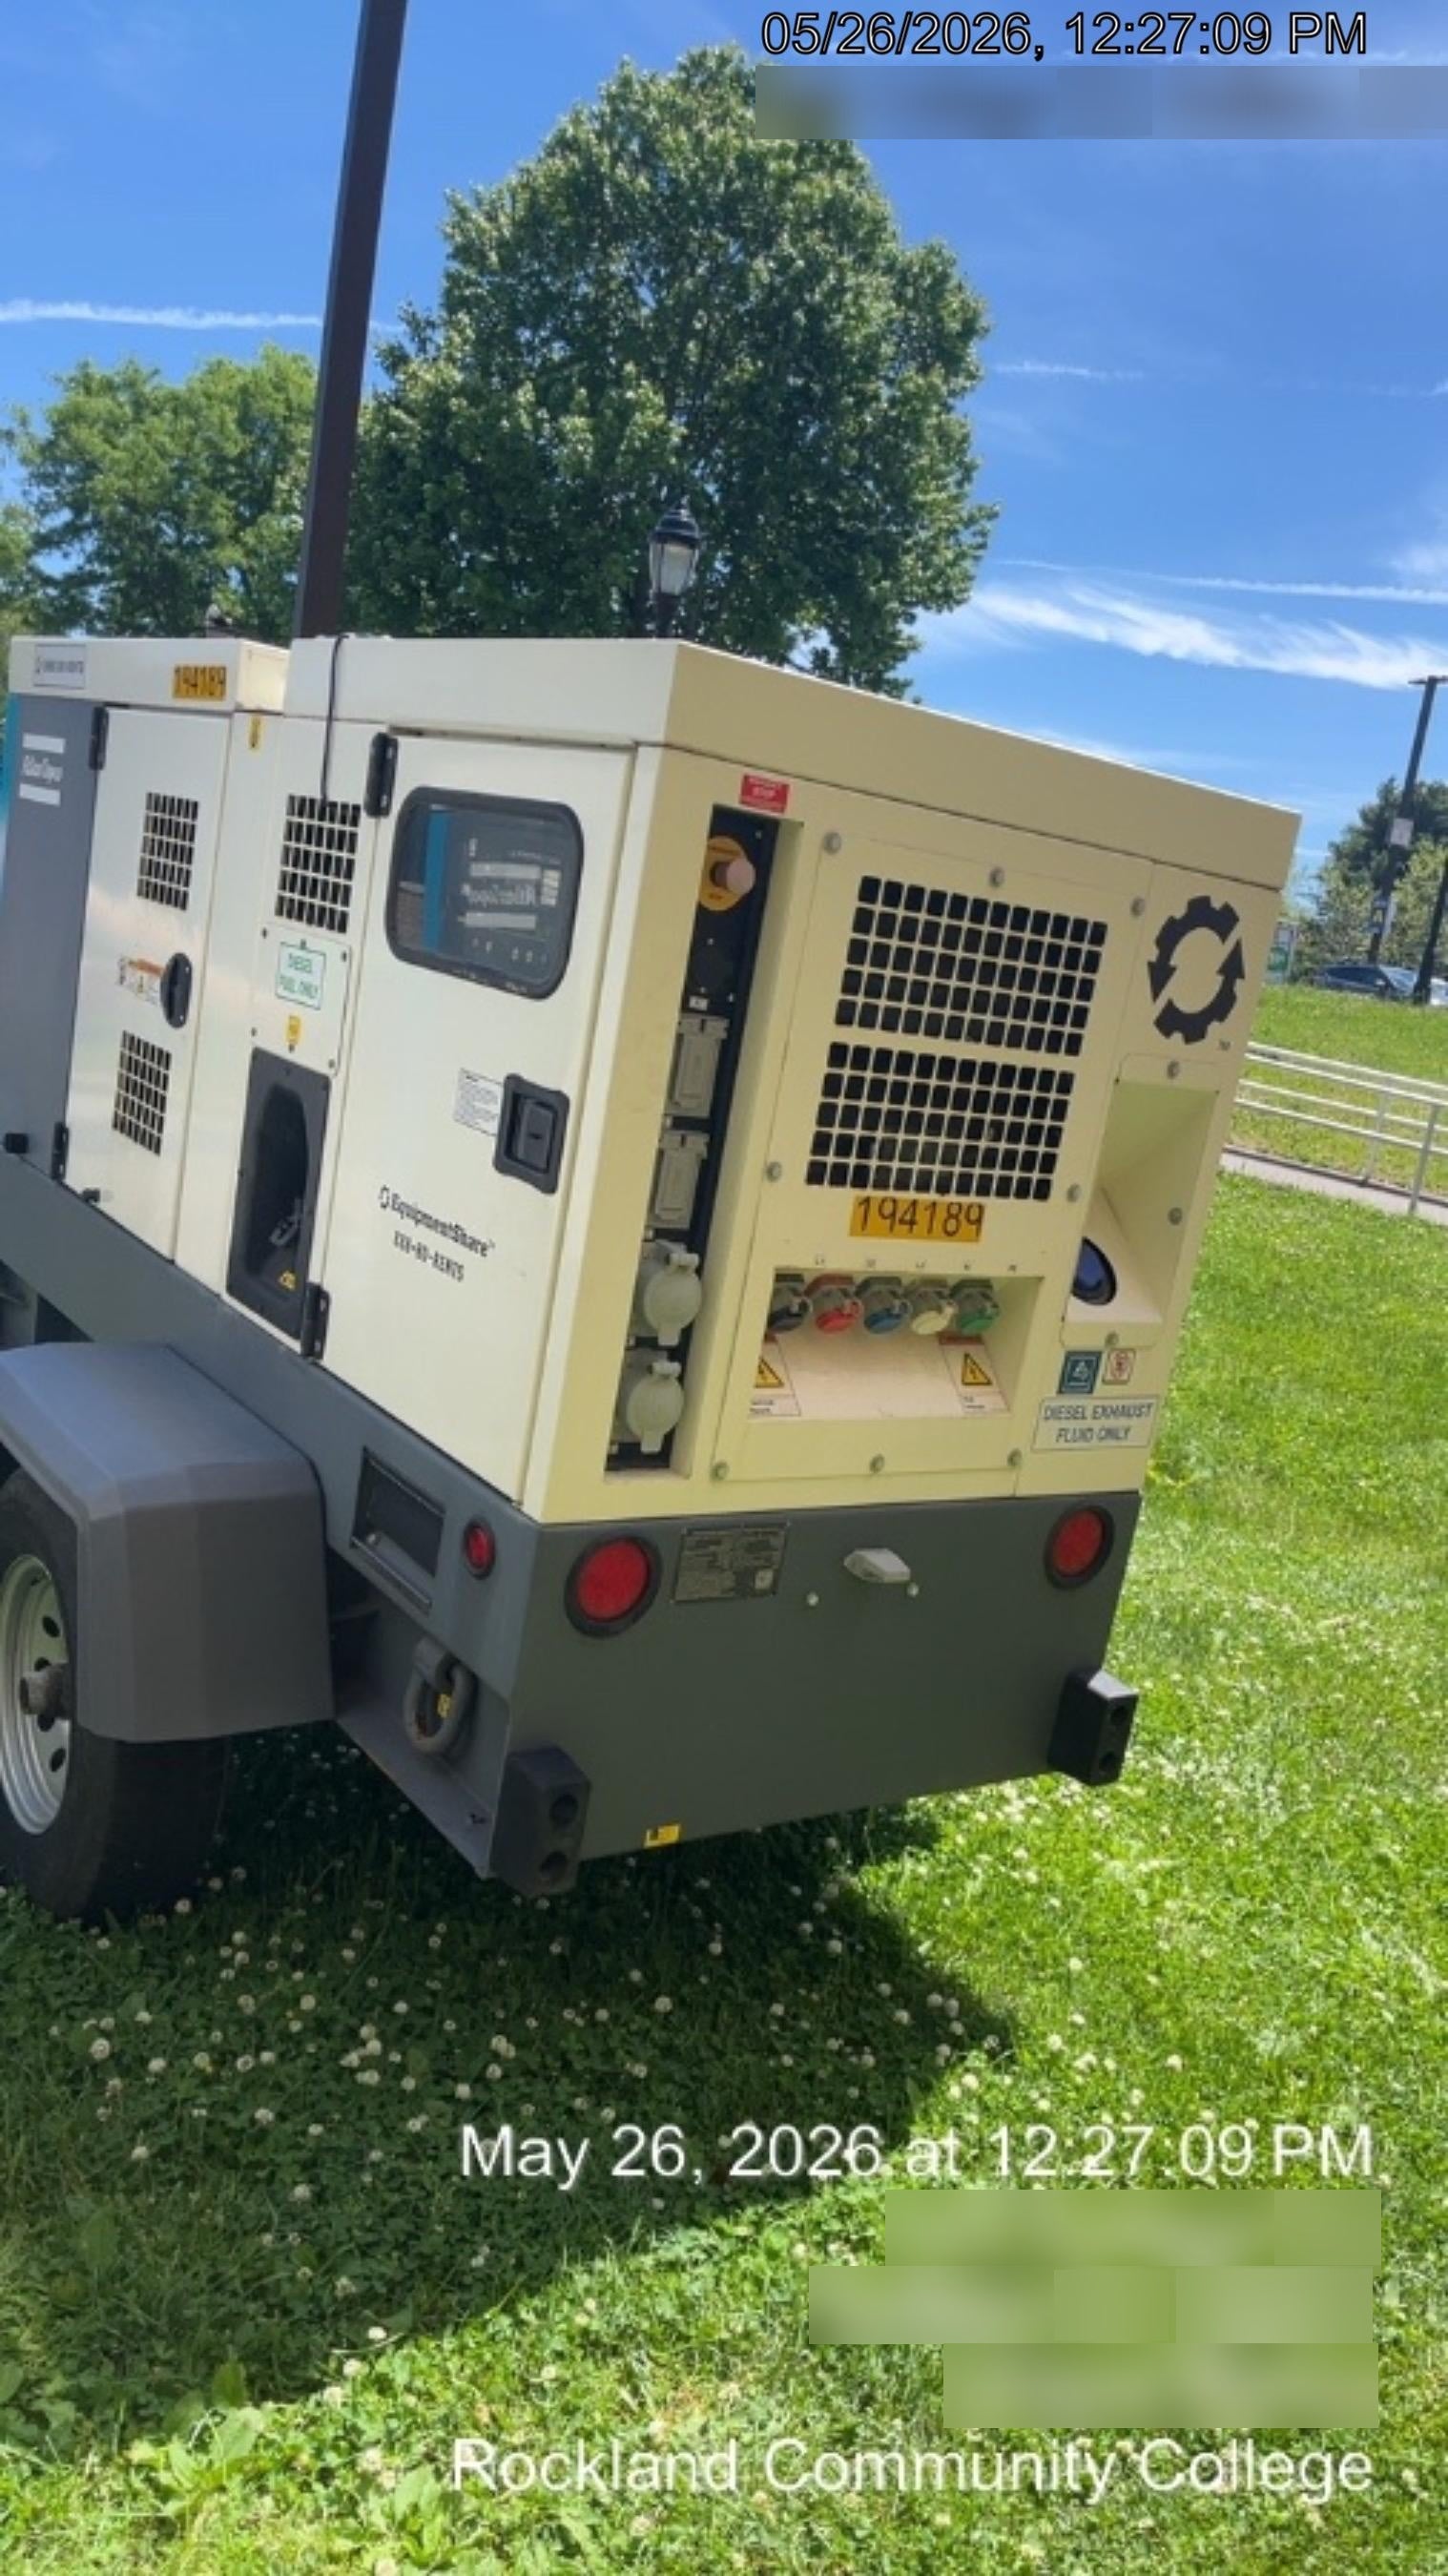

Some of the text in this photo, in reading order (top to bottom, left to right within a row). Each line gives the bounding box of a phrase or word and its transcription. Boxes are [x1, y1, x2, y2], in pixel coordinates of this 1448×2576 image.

[858, 1195, 984, 1237] 194189
[1044, 1402, 1153, 1421] DIESEL EXHAUST
[1055, 1425, 1131, 1443] FLUID ONLY
